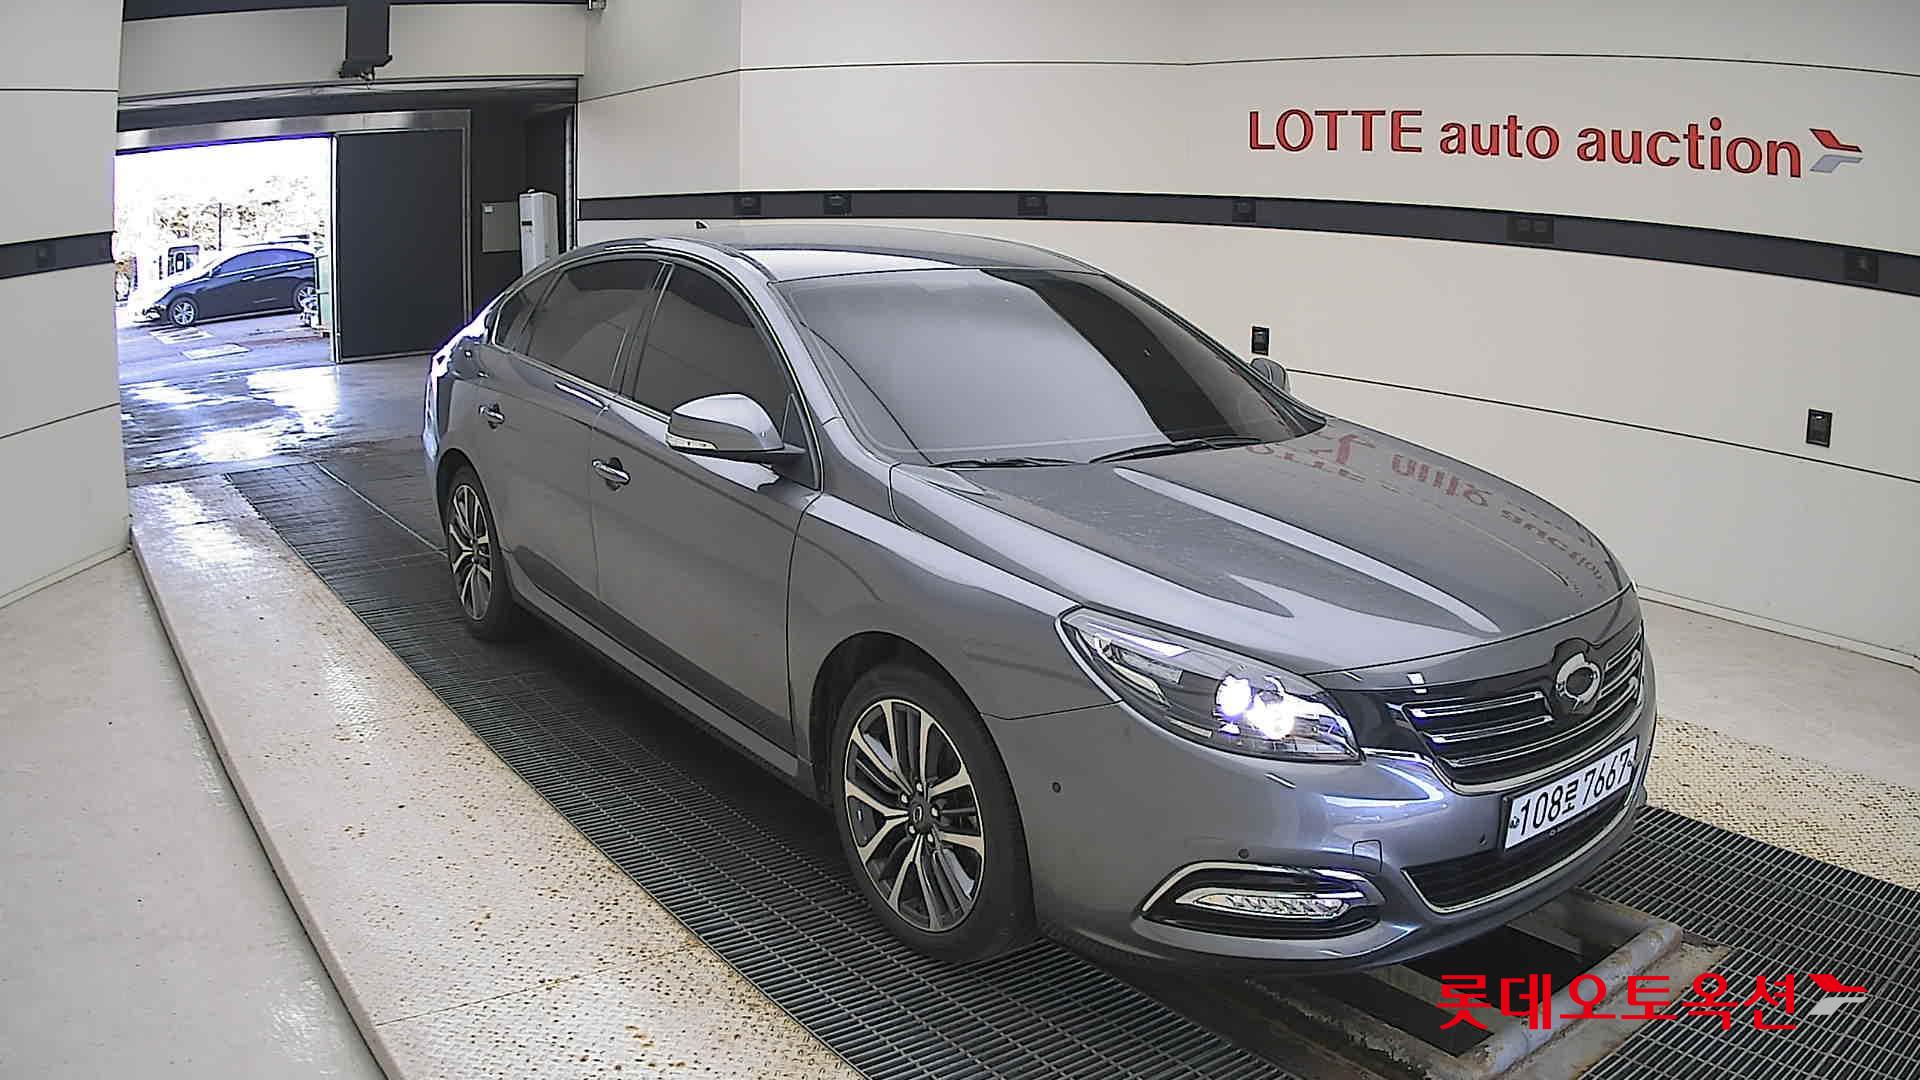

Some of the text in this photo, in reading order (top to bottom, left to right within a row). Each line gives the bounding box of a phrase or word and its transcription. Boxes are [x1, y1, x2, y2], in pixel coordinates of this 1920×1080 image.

[1250, 109, 1802, 178] LOTTE auto auction
[1520, 779, 1580, 836] 108로
[1582, 747, 1631, 806] 7667
